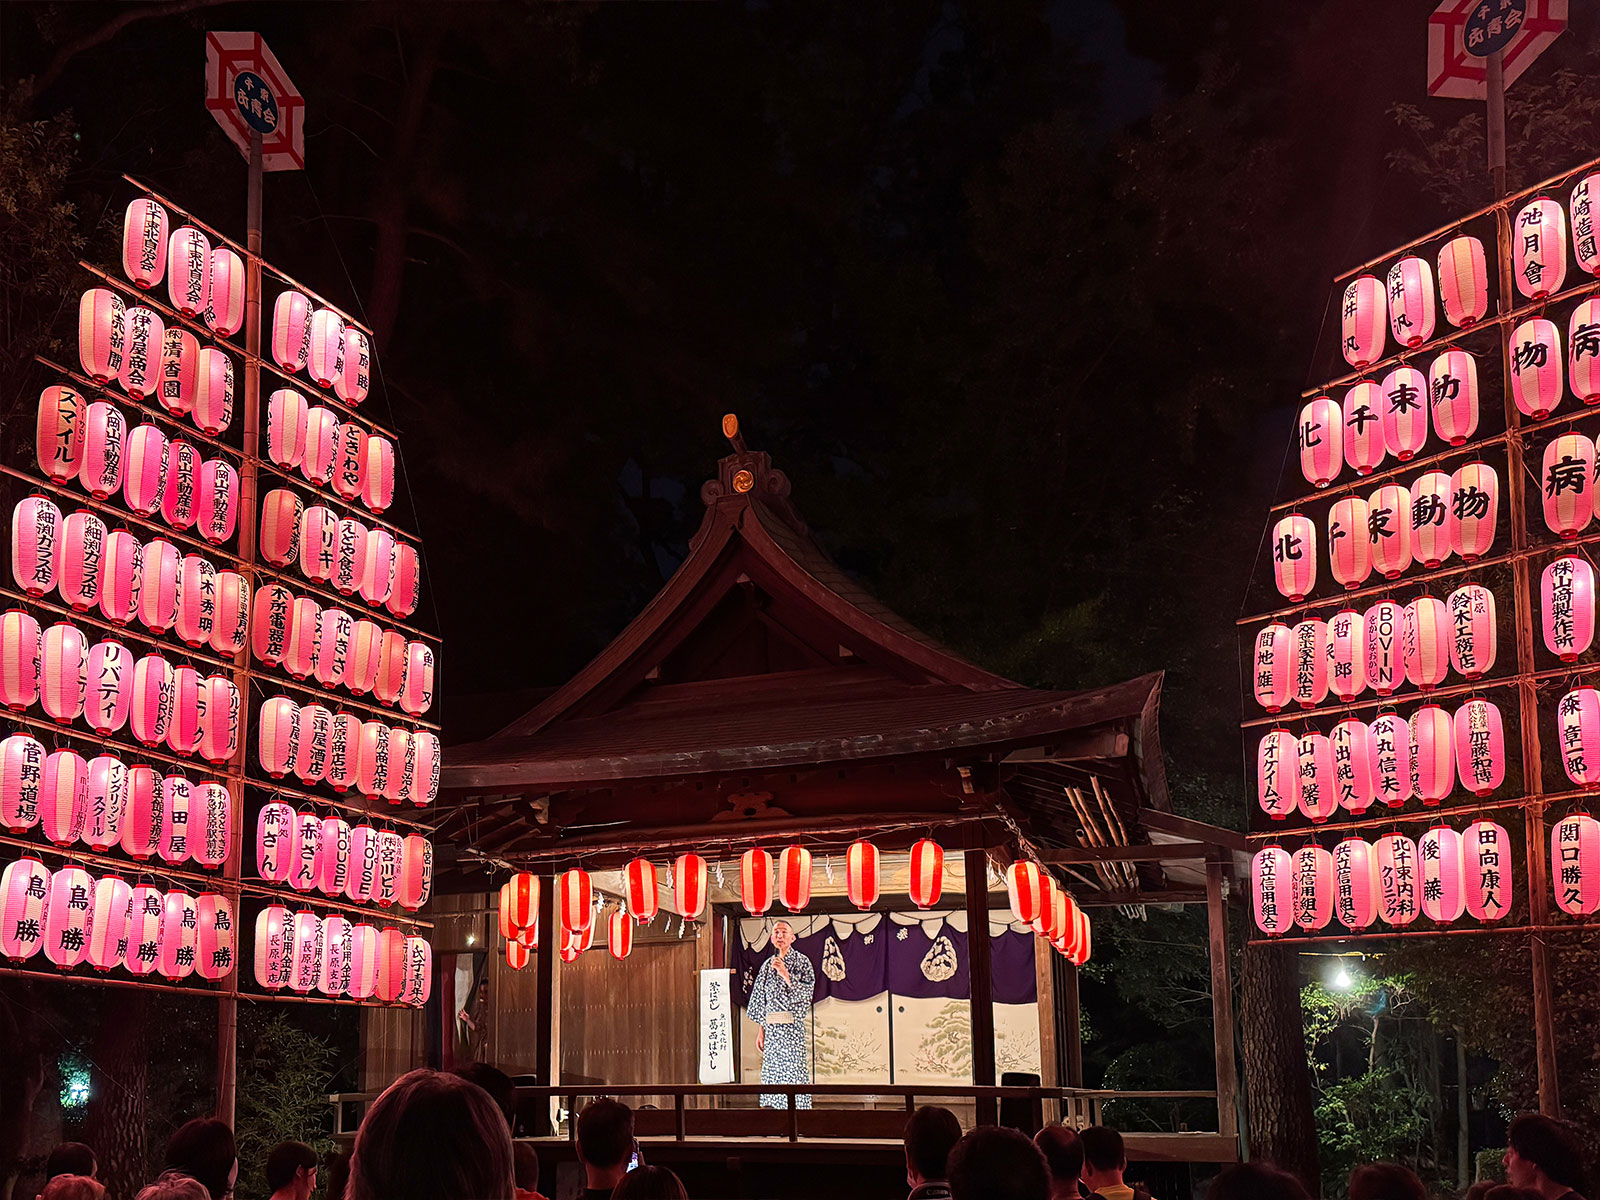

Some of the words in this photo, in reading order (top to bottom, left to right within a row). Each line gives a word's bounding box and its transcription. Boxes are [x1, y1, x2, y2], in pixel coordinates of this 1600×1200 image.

[140, 202, 161, 272] 北千束北自治会
[187, 231, 204, 304] 北千束北自治会
[1431, 374, 1461, 408] 動
[1512, 341, 1548, 377] 物
[54, 391, 76, 463] スマイル
[1346, 405, 1379, 436] 千
[1388, 384, 1421, 414] 束
[342, 426, 360, 486] ときわや
[1299, 421, 1322, 450] 北
[1452, 486, 1490, 520] 物
[1545, 455, 1586, 499] 病
[319, 510, 335, 568] トリキ
[1411, 494, 1447, 531] 動
[337, 521, 359, 586] えどや食堂
[1275, 534, 1302, 562] 北
[198, 561, 215, 633] 鈴木秀明
[1378, 607, 1393, 683] BOVIN
[1406, 605, 1415, 657] ヘアーメイク
[1451, 592, 1476, 670] 鈴木工務店
[98, 646, 122, 718] リバティ
[154, 681, 170, 735] WORKS
[422, 650, 432, 705] 魚又
[307, 709, 328, 776] 三津屋酒店
[329, 715, 347, 780] 長原商店街
[372, 726, 389, 791] 長原商店街
[398, 734, 415, 798] 長原自治会
[427, 737, 441, 800] 長原自治会
[1333, 727, 1360, 802] 小出純久
[1373, 719, 1401, 795] 松丸信夫
[1469, 730, 1494, 785] 加藤和博
[15, 742, 41, 822] 菅野道場
[107, 764, 122, 833] イングリッシュ
[91, 796, 106, 837] スクール
[168, 783, 189, 854] 池田屋
[261, 808, 281, 873] 赤さん
[298, 822, 317, 880] 赤さん
[333, 827, 348, 887] HOUSE
[359, 835, 375, 895] HOUSE
[1393, 839, 1416, 916] 北千束内科
[1421, 839, 1444, 902] 後藤
[1478, 829, 1503, 909] 田向康人
[1559, 823, 1584, 906] 関口勝久
[13, 874, 46, 943] 鳥勝
[1259, 851, 1278, 929] 共立信用組合
[1300, 851, 1318, 924] 共立信用組合
[1336, 843, 1358, 925] 共立信用組合
[1382, 865, 1397, 918] クリニック
[59, 885, 88, 952] 鳥勝
[136, 894, 161, 963] 鳥勝
[175, 907, 197, 967] 鳥勝
[212, 909, 232, 968] 鳥勝
[278, 913, 294, 983] 芝信用金庫
[267, 935, 281, 983] 長原支店
[298, 940, 312, 986] 長原支店
[328, 943, 341, 990] 長原支店
